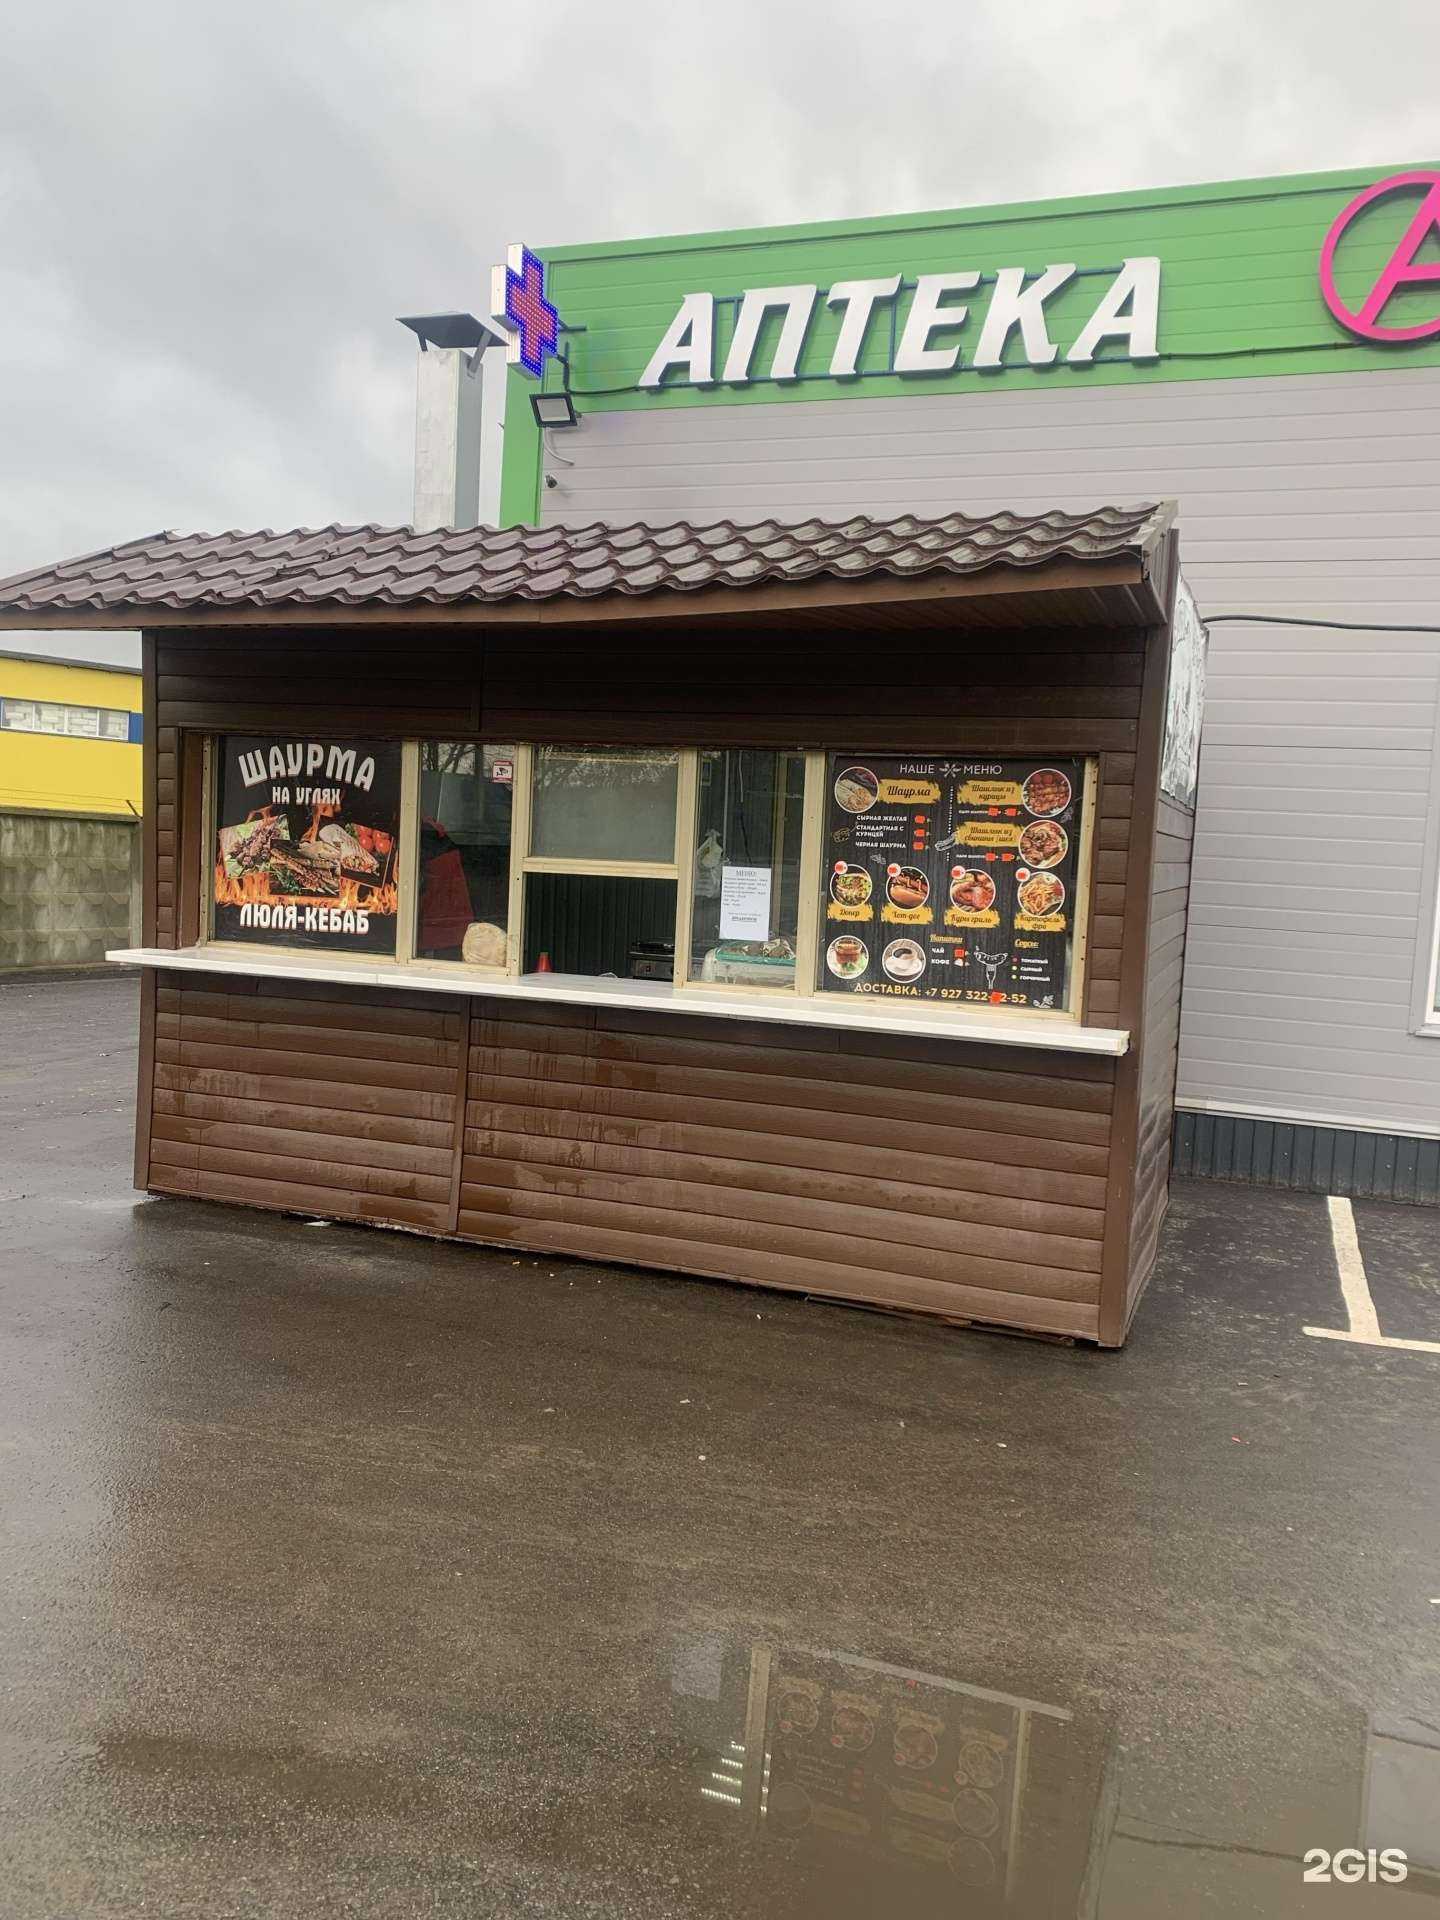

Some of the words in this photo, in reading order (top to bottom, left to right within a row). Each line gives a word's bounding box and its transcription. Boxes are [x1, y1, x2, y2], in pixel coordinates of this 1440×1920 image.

[638, 256, 1161, 387] АПТЕКА
[238, 743, 375, 792] ШАУРМА
[900, 764, 935, 774] НАШЕ
[963, 765, 1002, 775] МЕНЮ
[272, 786, 290, 803] НА
[296, 787, 341, 805] УГЛЯХ
[887, 785, 931, 798] Шаурма
[240, 903, 370, 934] ЛЮЛЯ-КЕБАБ
[931, 946, 944, 954] ЧАЙ
[854, 983, 921, 996] ДОСТАВКА:
[925, 987, 937, 997] +7
[941, 989, 962, 998] 927
[966, 990, 1027, 1003] 322-2-52
